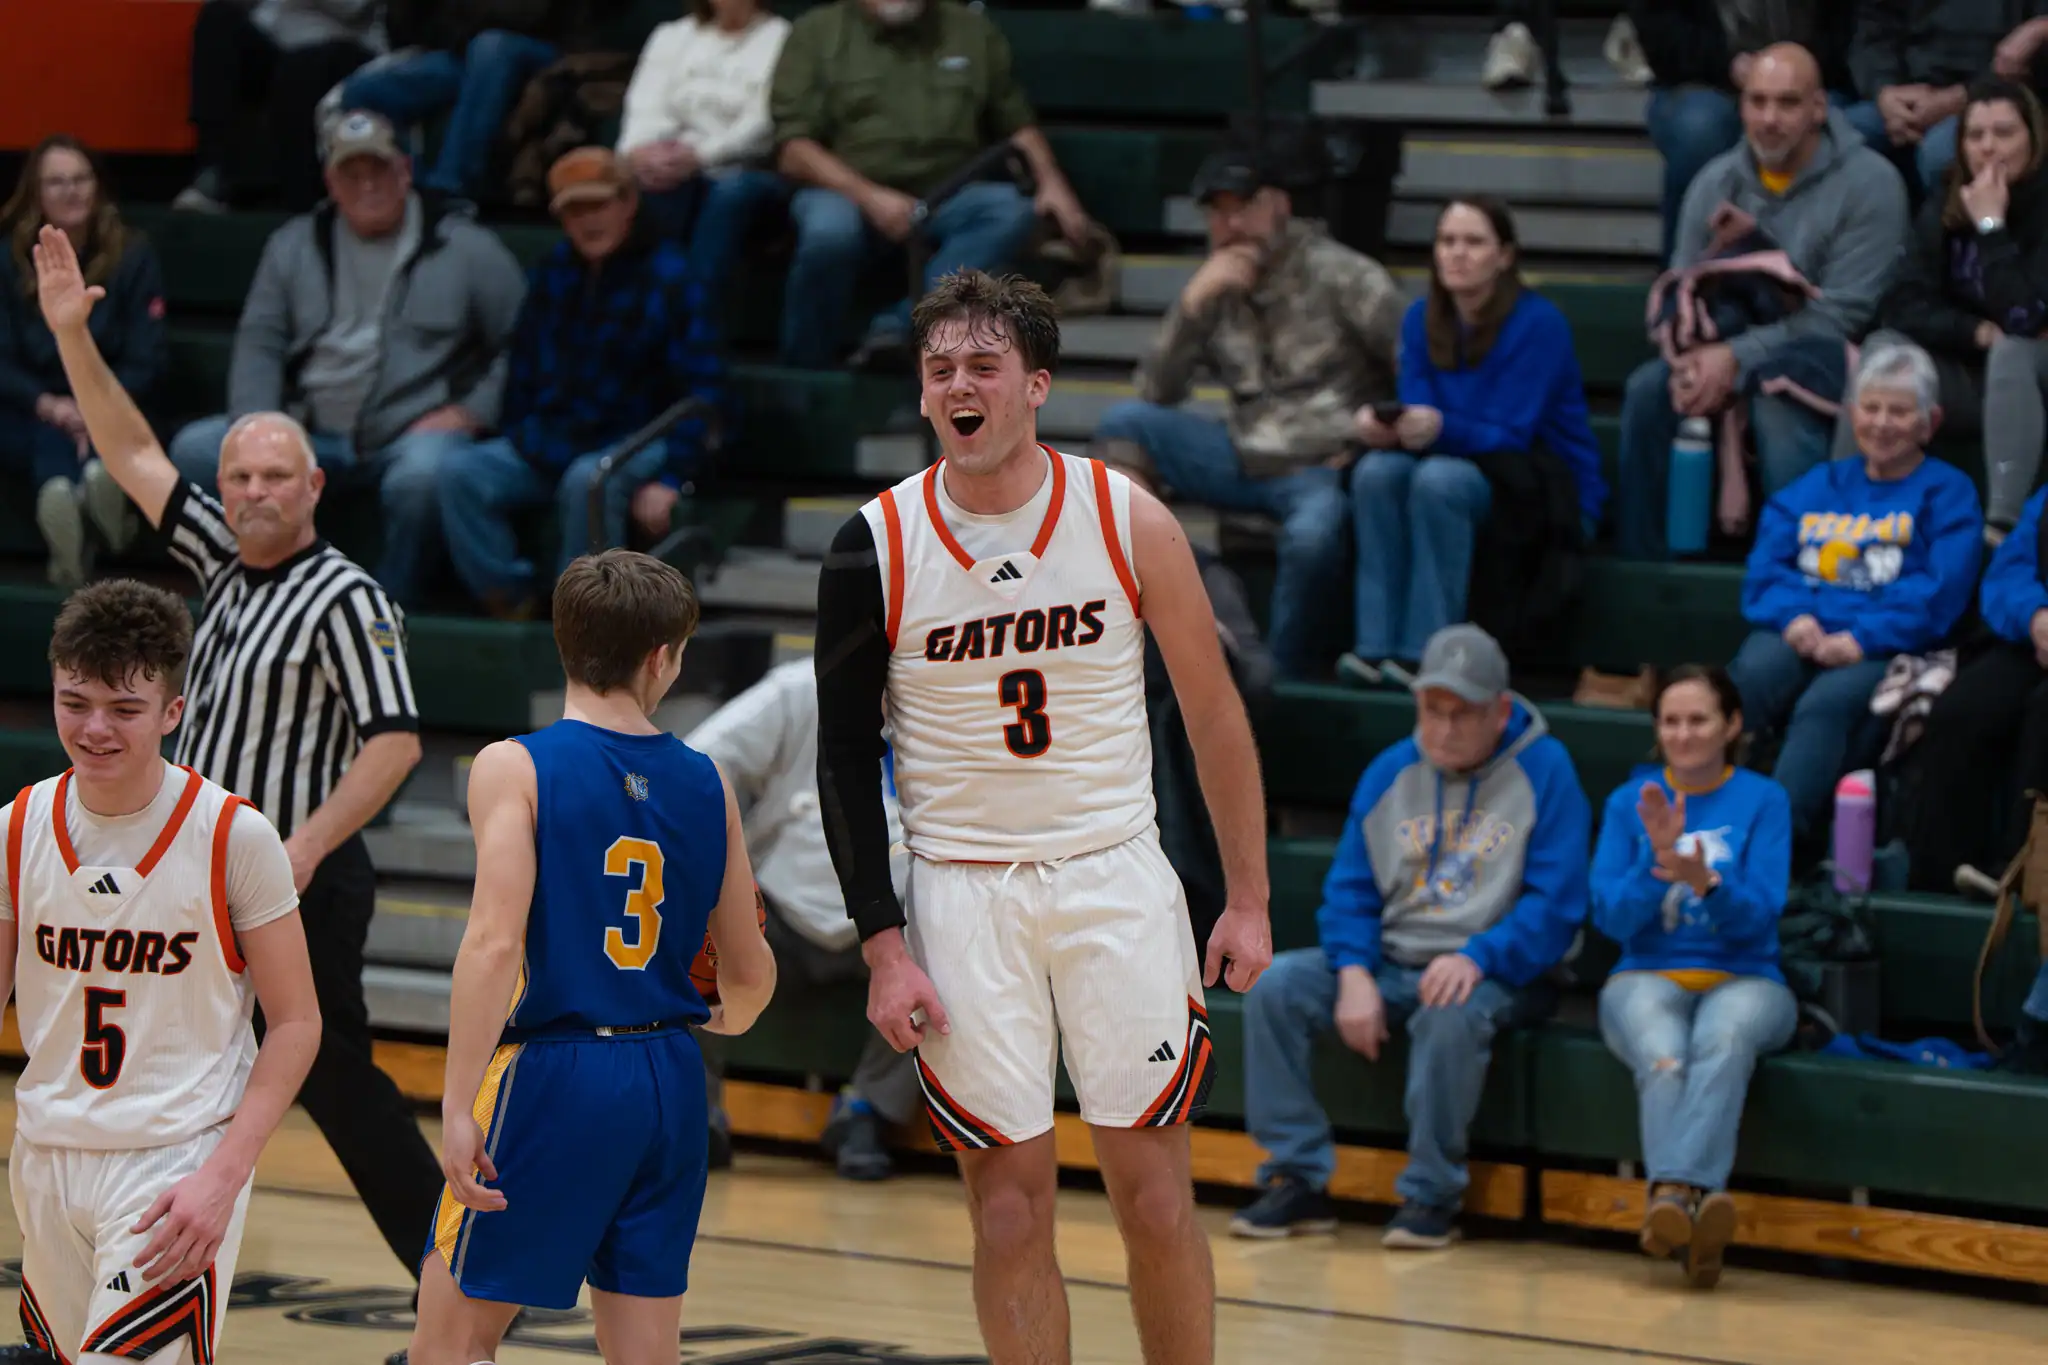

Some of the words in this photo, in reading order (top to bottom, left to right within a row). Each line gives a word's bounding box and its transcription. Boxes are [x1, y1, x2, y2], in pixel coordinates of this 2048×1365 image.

[925, 599, 1106, 662] GATORS
[998, 668, 1053, 759] 3
[603, 835, 665, 971] 3
[35, 923, 200, 976] GATORS
[80, 986, 127, 1090] 5
